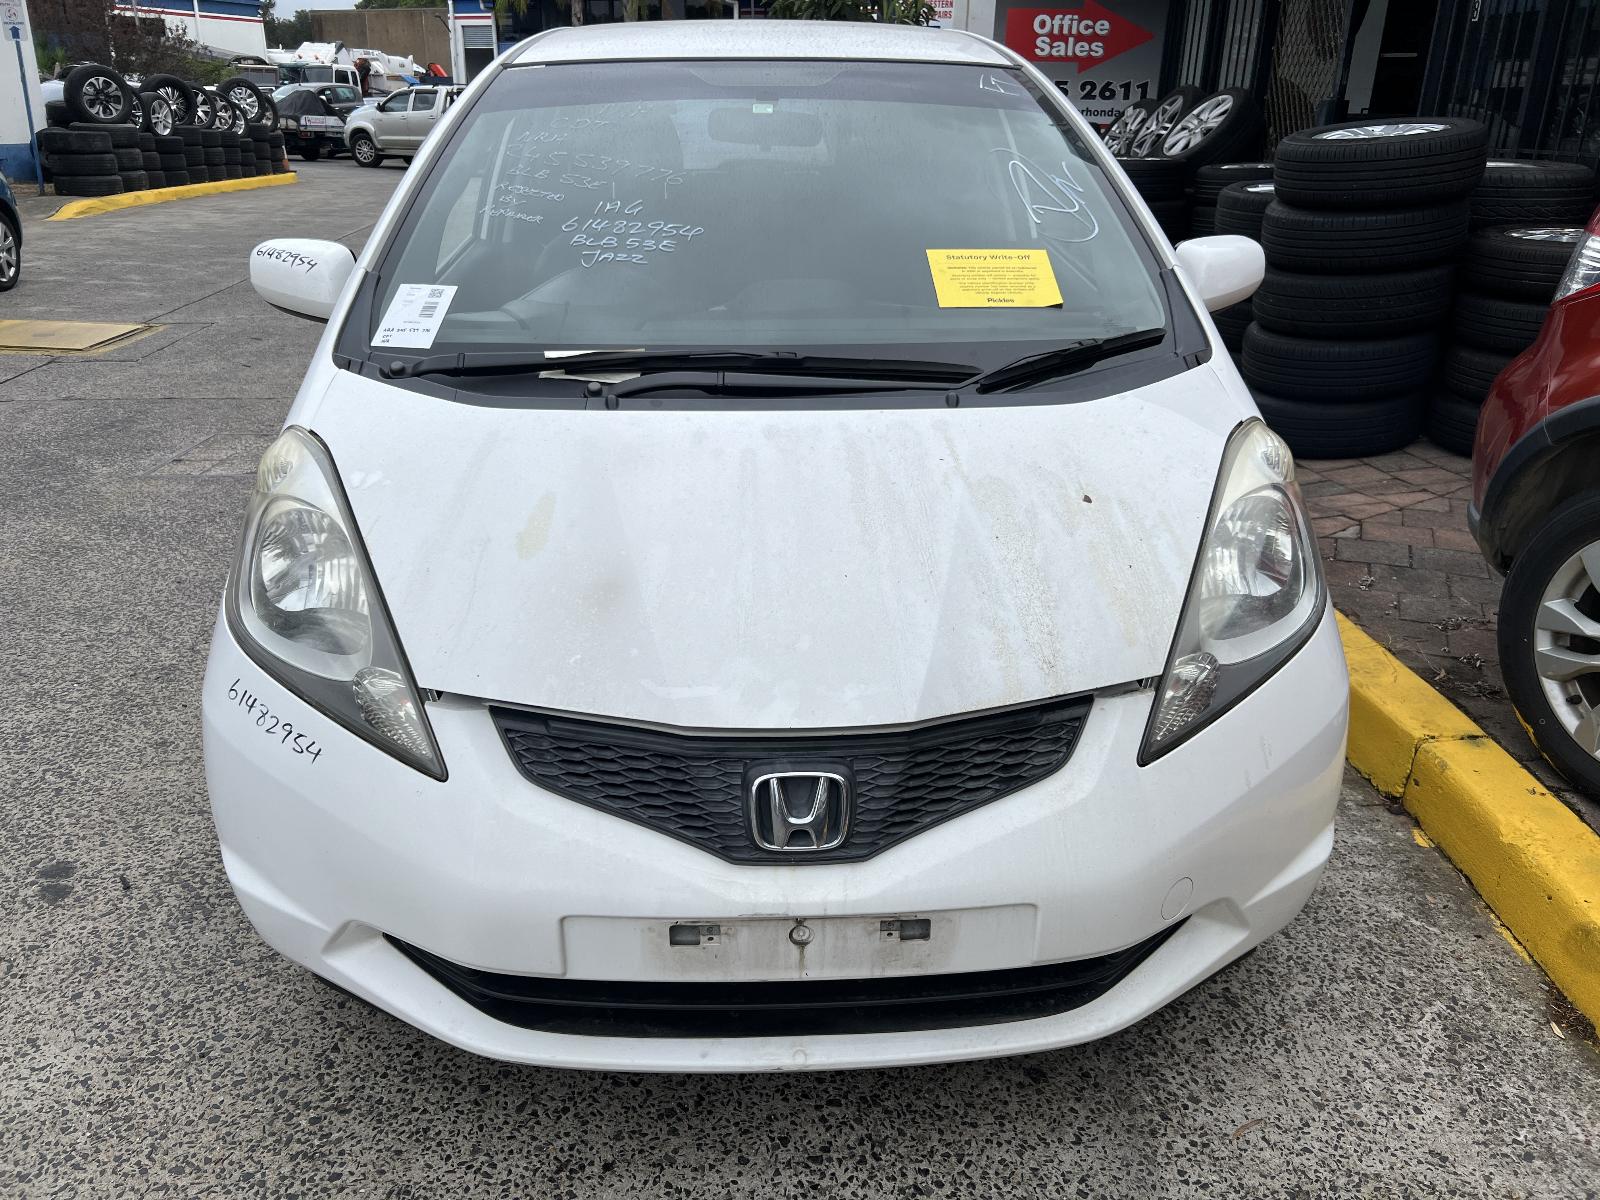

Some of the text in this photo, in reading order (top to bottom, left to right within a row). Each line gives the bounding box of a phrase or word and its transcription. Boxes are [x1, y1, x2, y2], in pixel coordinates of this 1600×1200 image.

[1033, 14, 1110, 35] Office
[1034, 36, 1104, 57] Sales
[1079, 80, 1149, 101] 2611
[1079, 107, 1121, 118] rhonda
[570, 234, 678, 252] BLB 53E
[256, 245, 318, 274] 61482954
[581, 250, 648, 268] JAZZ
[227, 678, 323, 764] 61482954
